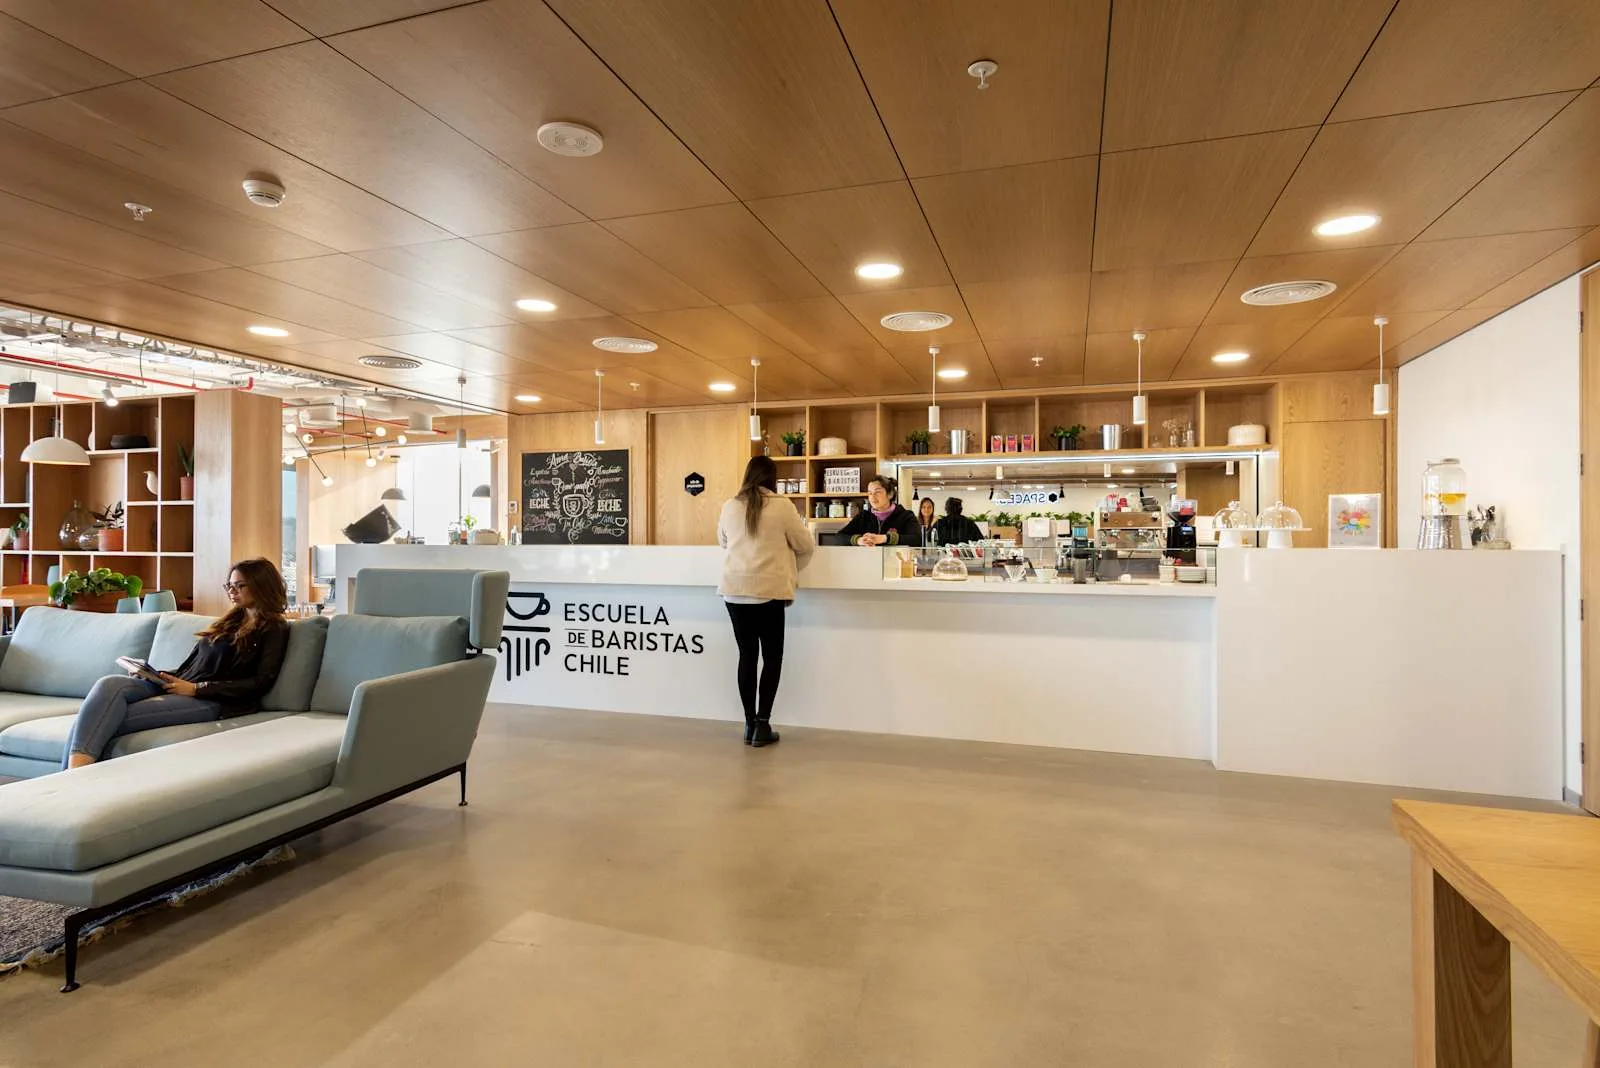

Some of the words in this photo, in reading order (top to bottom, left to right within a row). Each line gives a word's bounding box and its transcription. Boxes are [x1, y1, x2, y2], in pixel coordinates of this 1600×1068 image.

[529, 498, 550, 509] LECHE
[597, 499, 622, 512] LECHE
[564, 603, 669, 626] ESCUELA
[568, 632, 585, 644] DE
[592, 630, 704, 654] BARISTAS
[564, 654, 630, 676] CHILE
